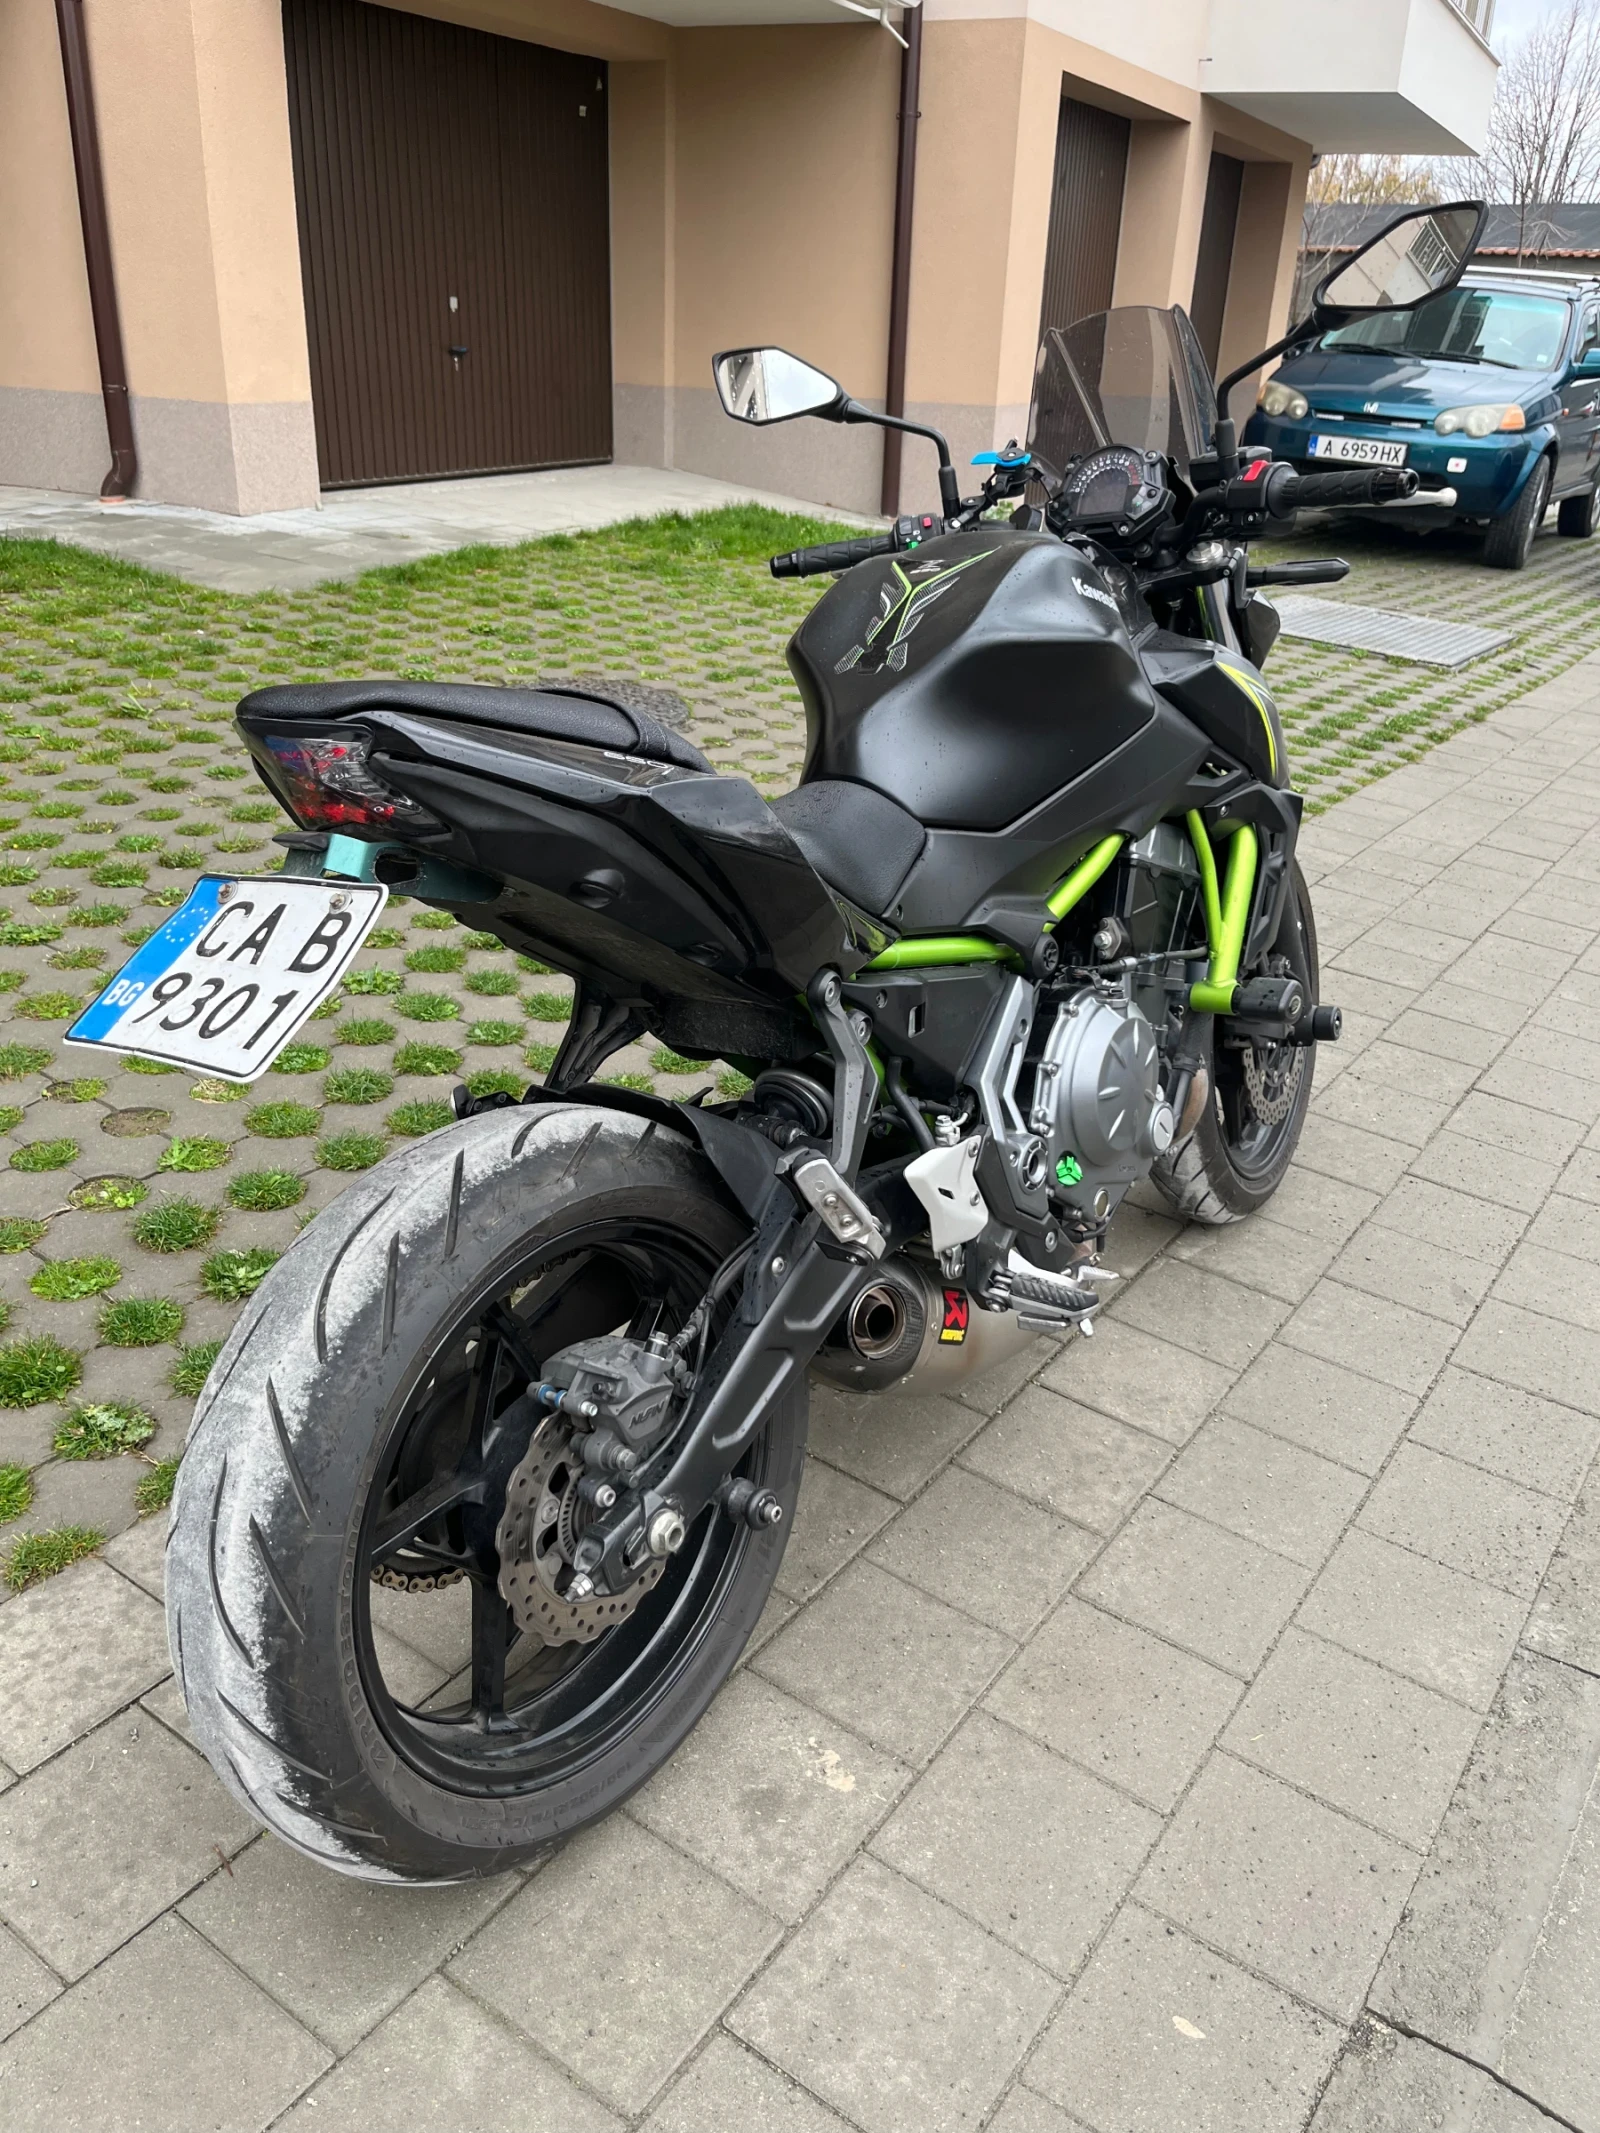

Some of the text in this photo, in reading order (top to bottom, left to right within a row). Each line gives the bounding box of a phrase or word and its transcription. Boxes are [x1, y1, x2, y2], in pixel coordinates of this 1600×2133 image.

[1324, 440, 1333, 455] A
[1340, 442, 1379, 460] 6959
[1380, 444, 1402, 463] HX
[1071, 576, 1119, 613] Kawasa
[195, 900, 353, 974] CA B
[102, 978, 145, 1007] BG
[132, 972, 301, 1051] 9301
[339, 1503, 389, 1769] BRIDGESTONE
